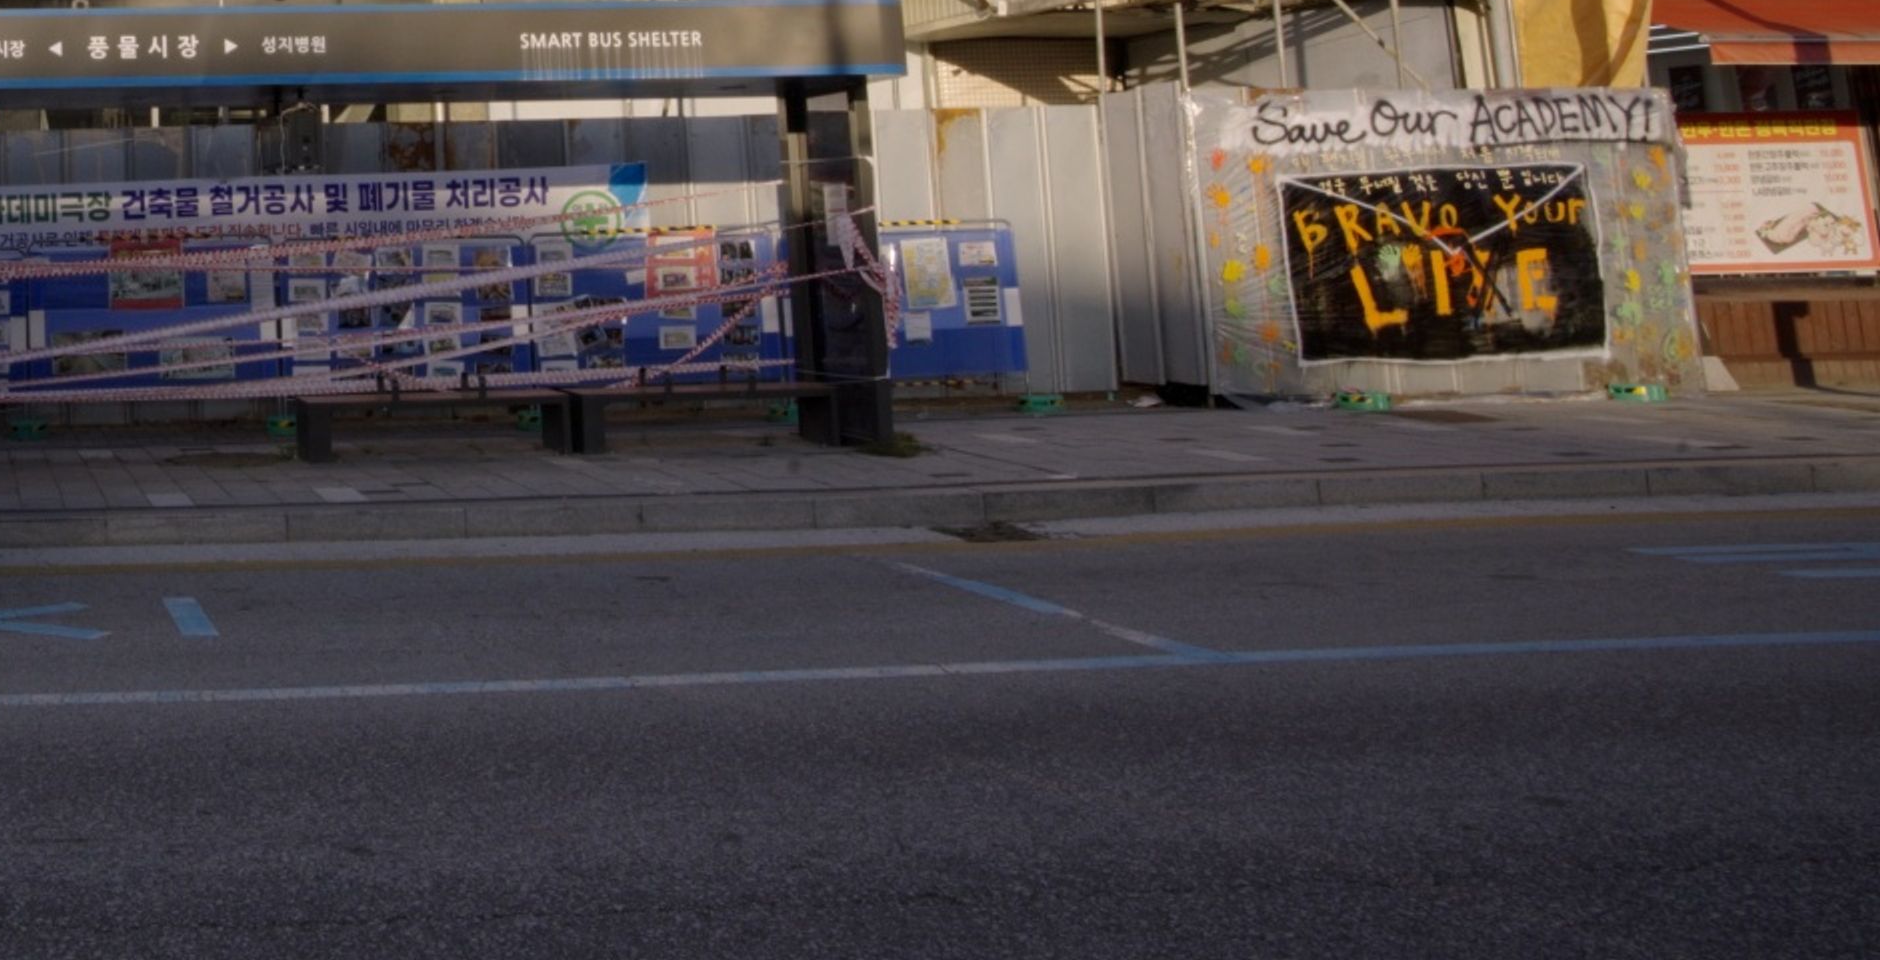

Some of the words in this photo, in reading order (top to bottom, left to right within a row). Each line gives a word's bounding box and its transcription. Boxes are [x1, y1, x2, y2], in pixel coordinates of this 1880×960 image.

[86, 34, 199, 59] 풍물시장
[261, 35, 327, 54] 성지병원
[520, 31, 582, 50] SMART
[588, 31, 623, 49] BUS
[628, 29, 702, 49] SHELTER
[1252, 101, 1366, 146] Save
[1370, 99, 1456, 136] Our
[1456, 170, 1488, 190] 당신
[121, 186, 199, 222] 건축물
[209, 182, 315, 218] 철거공사
[324, 182, 348, 214] 및
[358, 180, 435, 212] 폐기물
[446, 176, 549, 208] 처리공사
